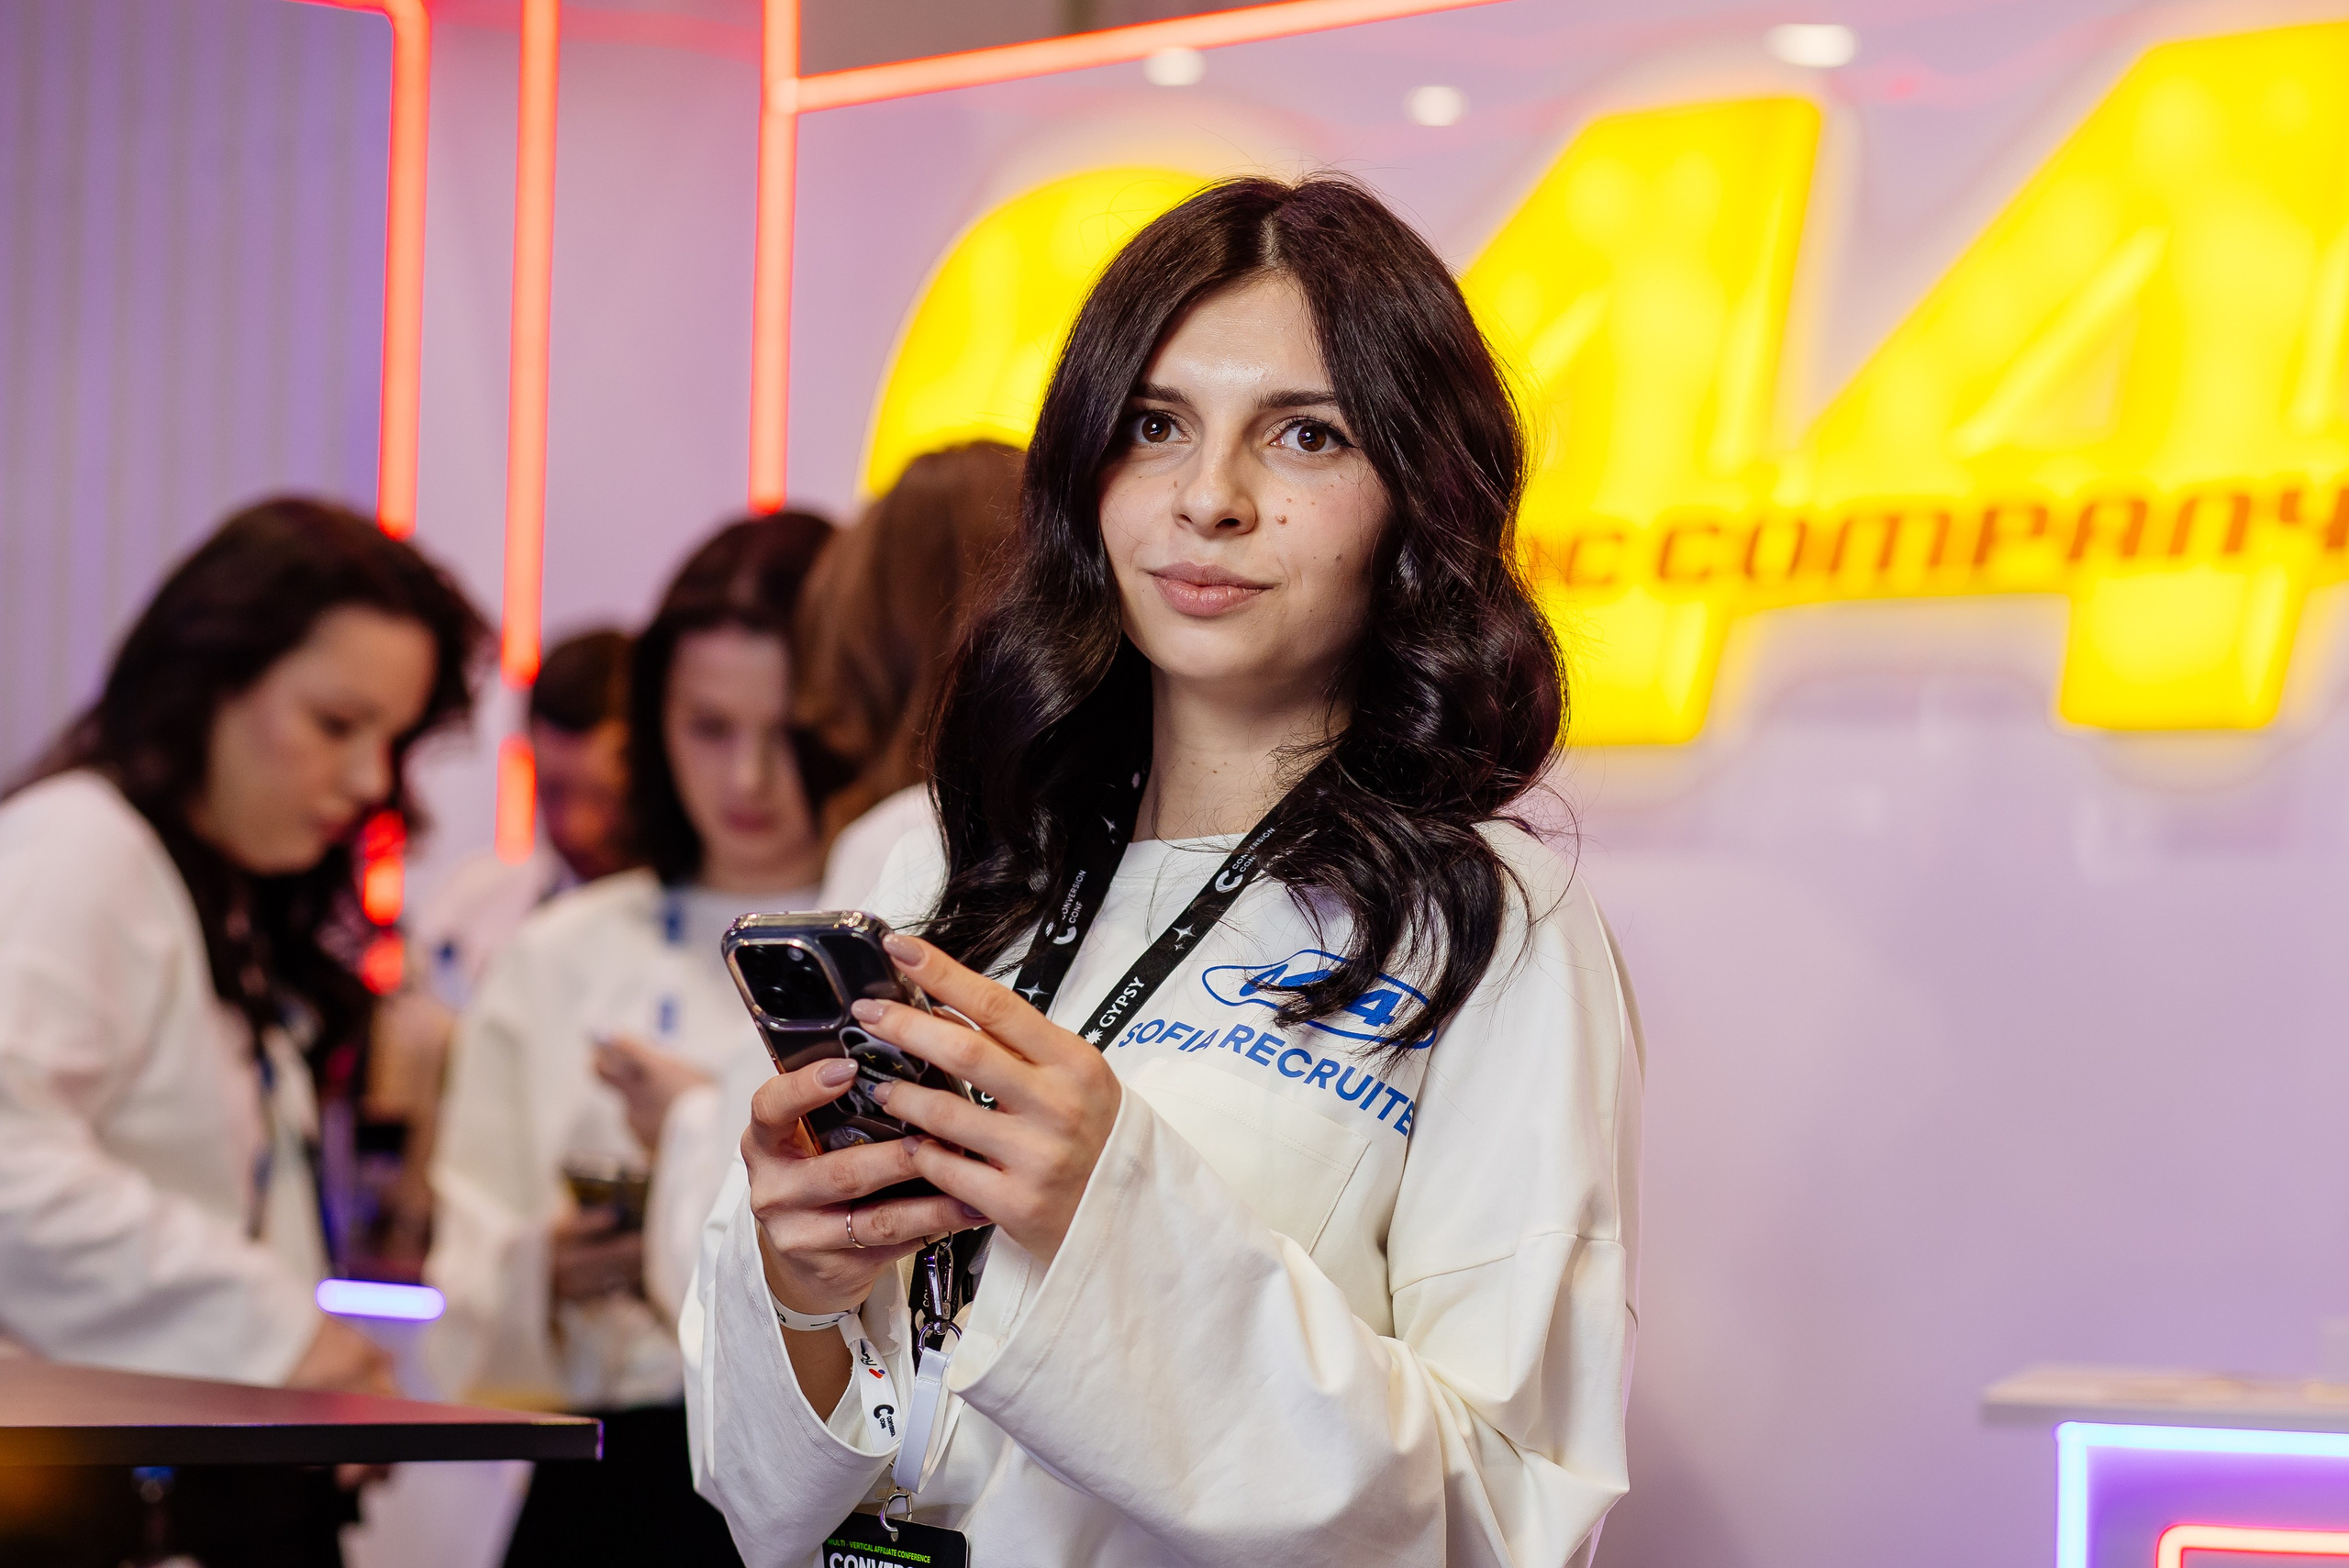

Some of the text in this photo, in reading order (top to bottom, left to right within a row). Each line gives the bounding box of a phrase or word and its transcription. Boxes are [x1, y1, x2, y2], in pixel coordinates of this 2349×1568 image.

[1068, 901, 1083, 924] CONF
[1098, 975, 1145, 1028] GYPSY
[1118, 1018, 1220, 1052] SOFIA
[827, 1538, 845, 1547] MULTI
[849, 1540, 874, 1551] VERTICAL
[874, 1545, 897, 1557] AFFILIATE
[897, 1550, 931, 1563] CONFERENCE
